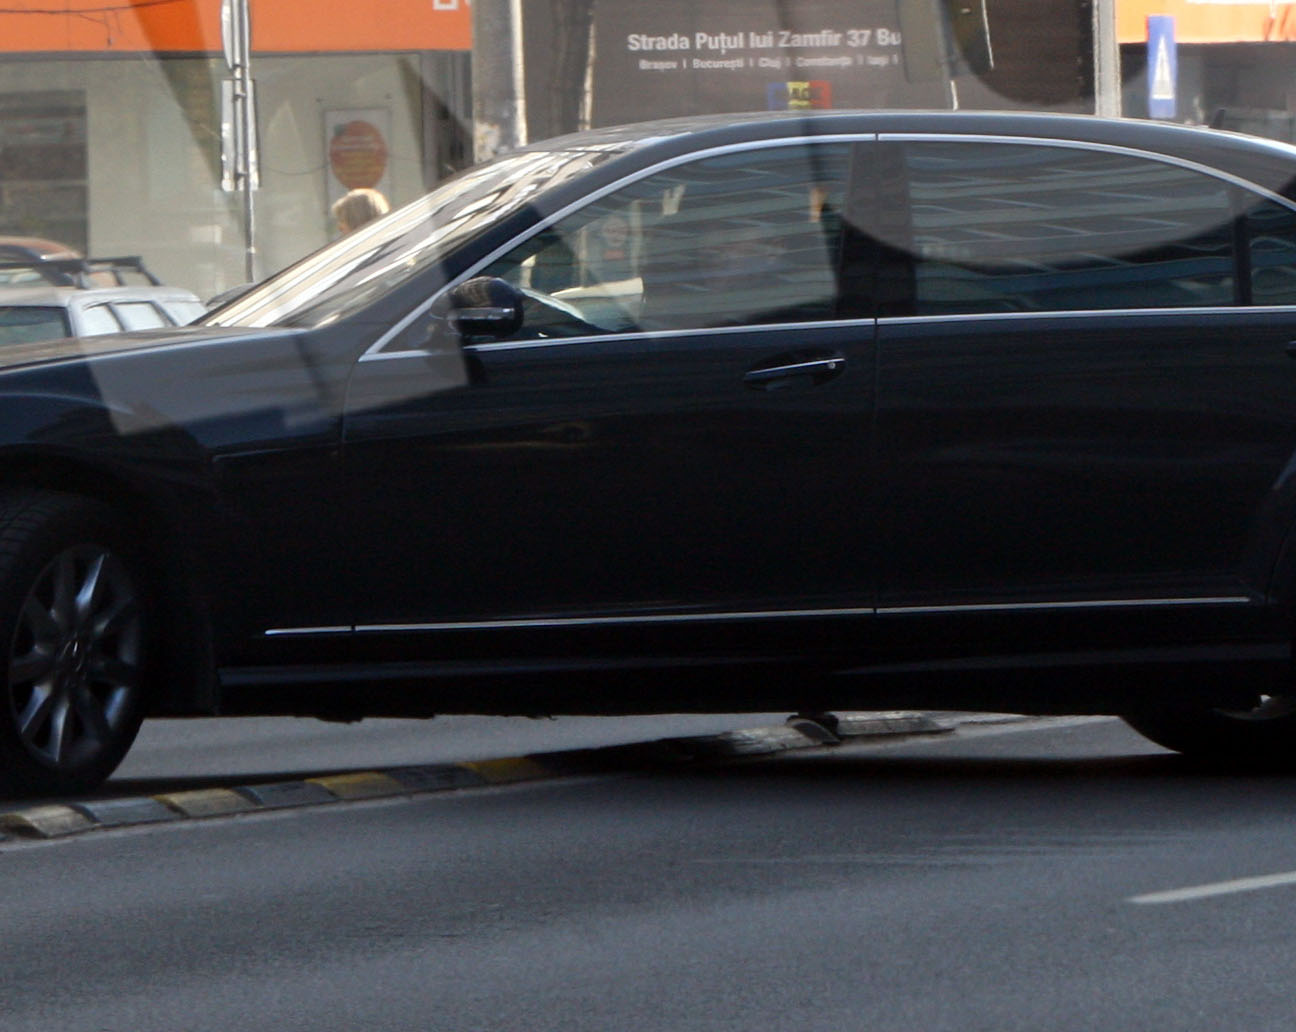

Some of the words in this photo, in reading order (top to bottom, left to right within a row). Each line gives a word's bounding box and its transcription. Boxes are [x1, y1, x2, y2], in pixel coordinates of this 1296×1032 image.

[627, 32, 691, 51] Strada
[750, 30, 775, 49] lui
[778, 28, 843, 48] Zamfir
[846, 28, 872, 48] 37
